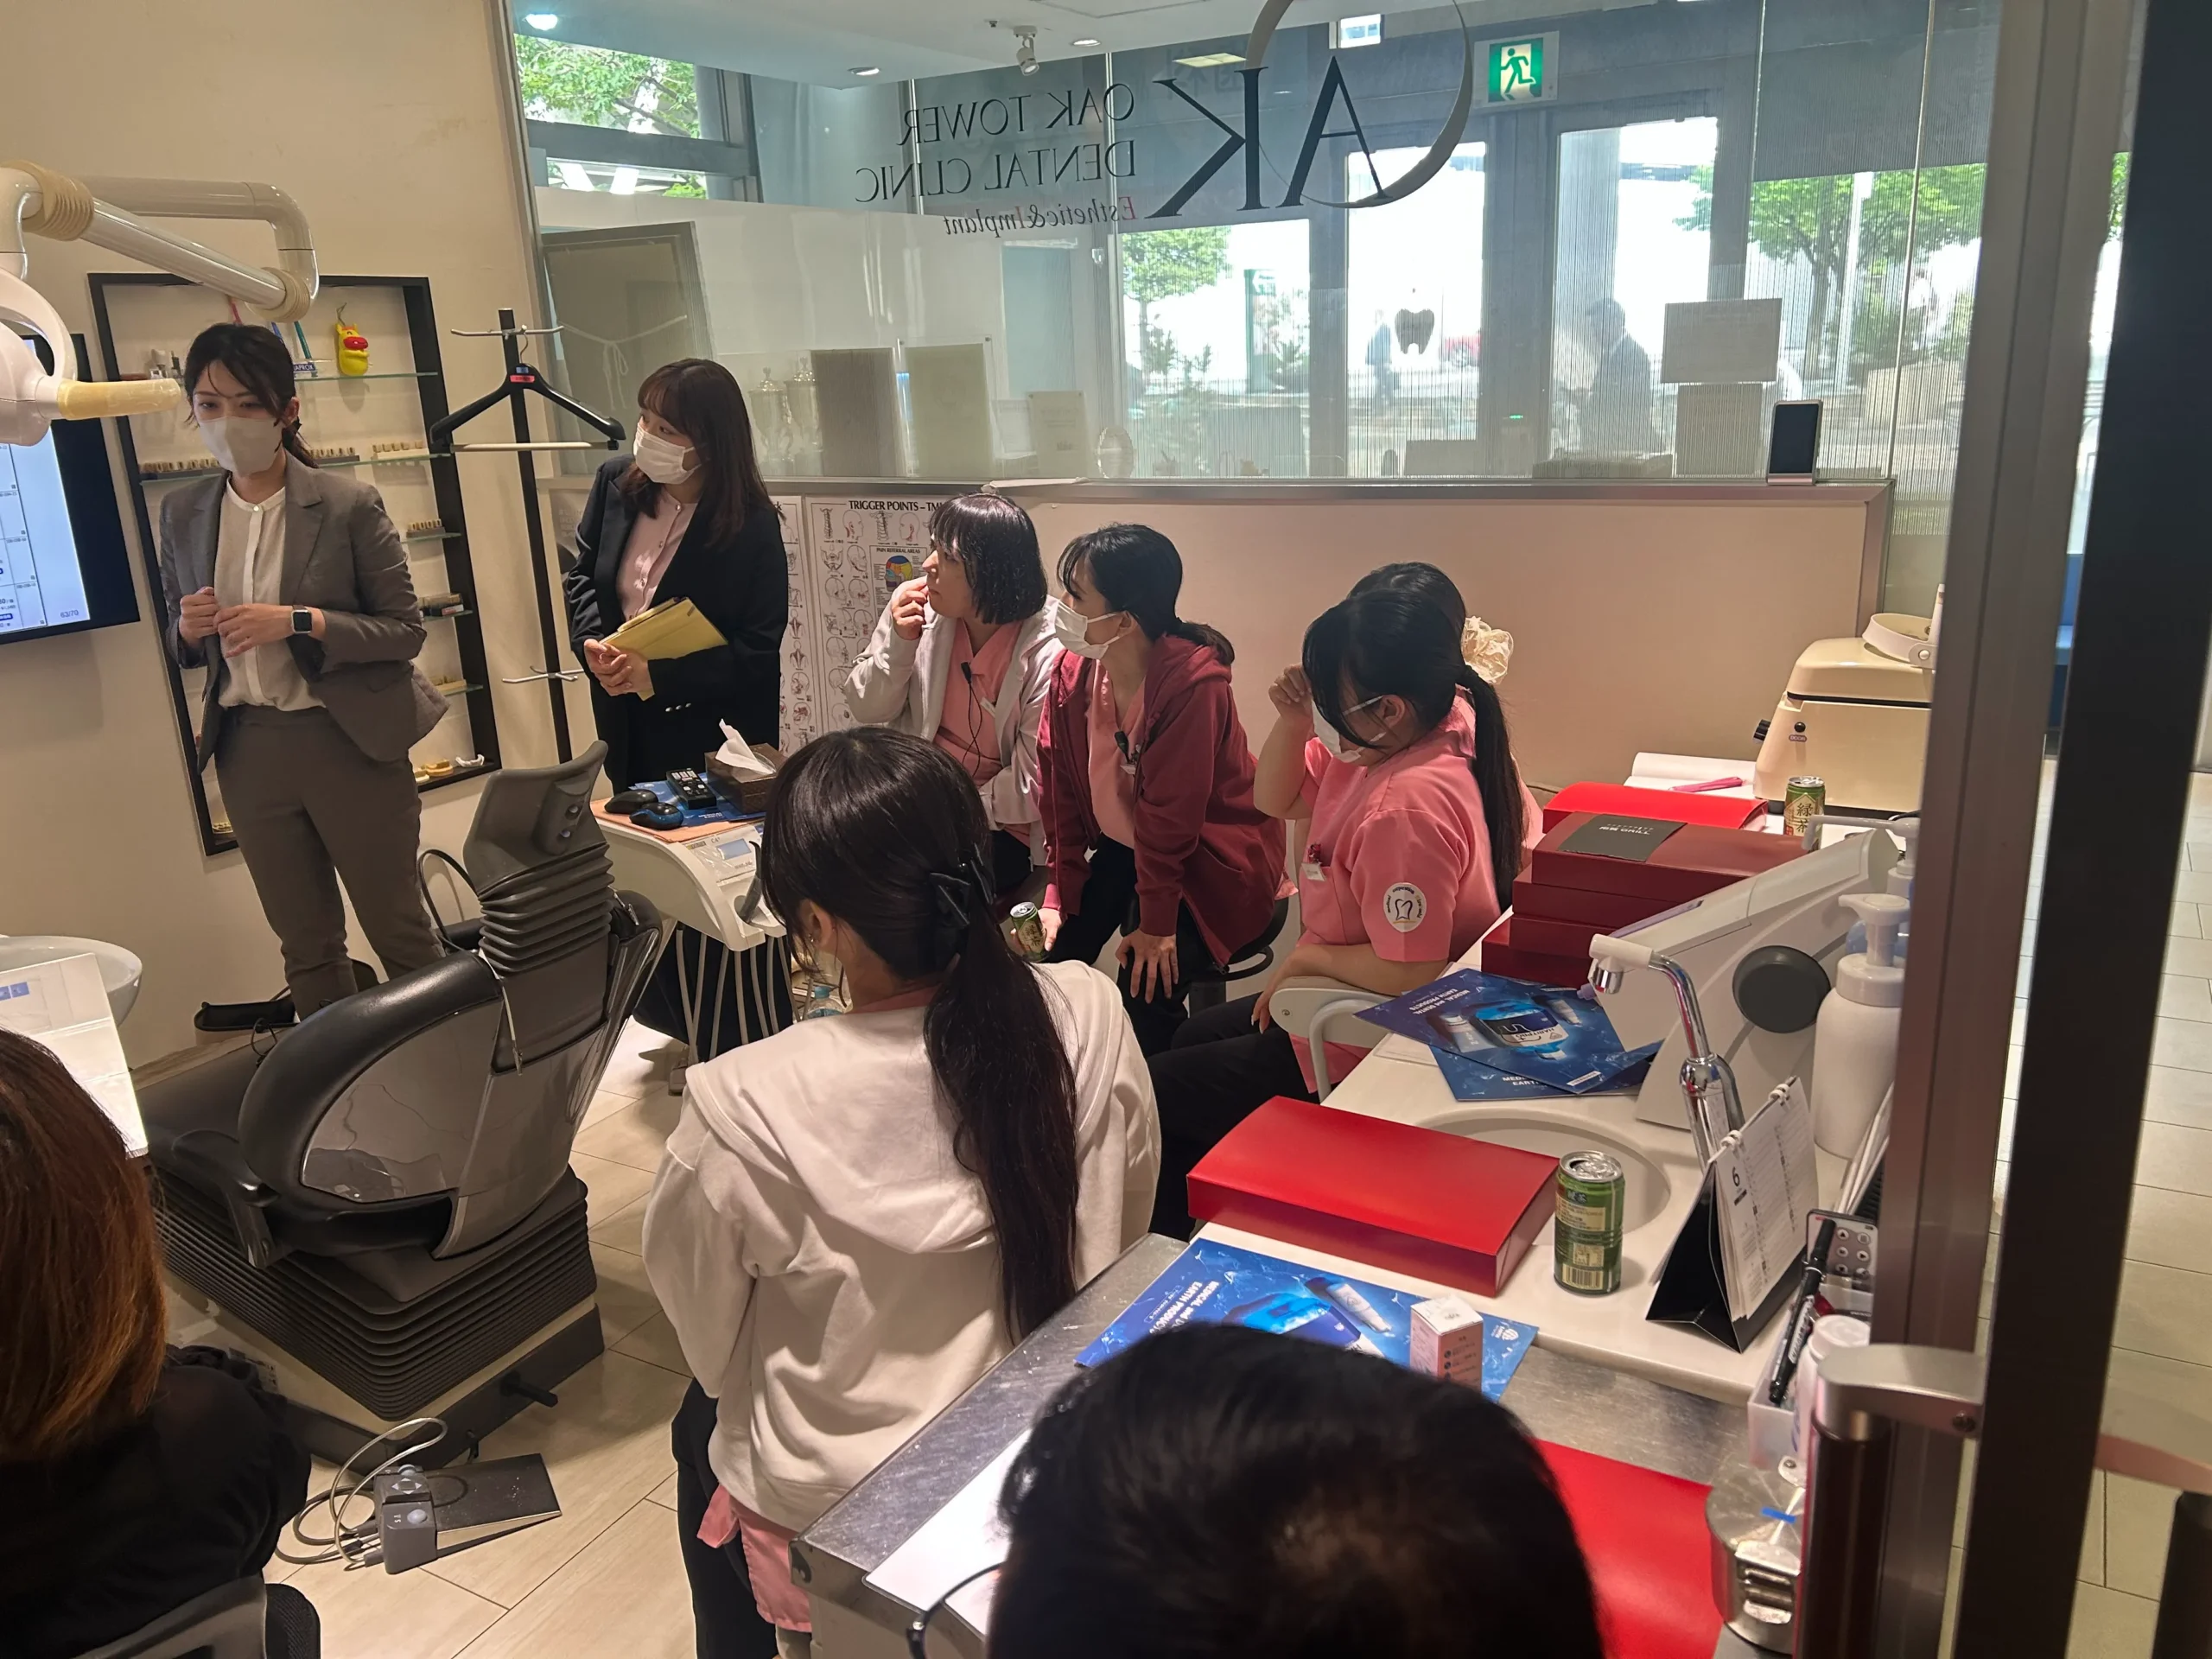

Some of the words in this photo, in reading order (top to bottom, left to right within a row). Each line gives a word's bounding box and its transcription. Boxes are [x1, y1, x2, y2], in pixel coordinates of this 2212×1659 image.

[849, 500, 886, 511] TRIGGER
[887, 501, 918, 512] POINTS
[1731, 1166, 1741, 1188] 6
